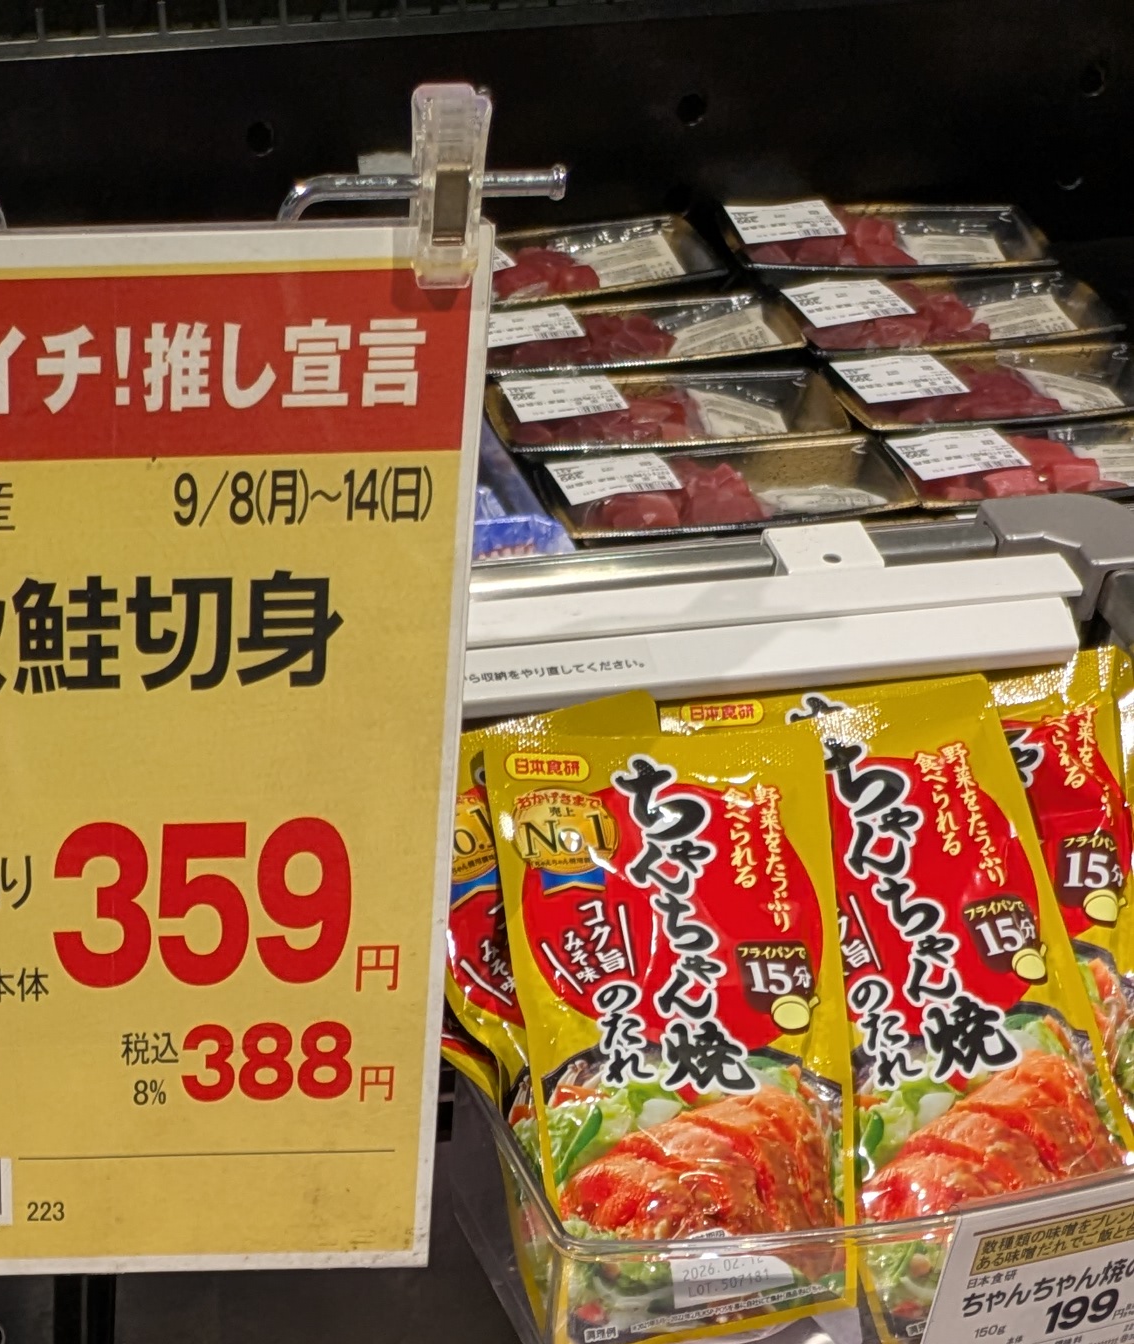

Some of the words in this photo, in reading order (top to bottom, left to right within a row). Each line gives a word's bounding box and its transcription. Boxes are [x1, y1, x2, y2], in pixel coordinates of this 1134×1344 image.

[689, 704, 755, 723] 日本食研
[512, 757, 582, 779] 日本食研
[913, 750, 963, 857] 食べられる
[721, 785, 758, 890] 食べられる
[1063, 852, 1110, 888] 15
[53, 817, 352, 988] 359
[355, 944, 401, 992] 円
[616, 757, 759, 1092] ちゃんちゃん焼
[564, 931, 600, 984] みそ味
[579, 900, 628, 974] コク旨
[736, 945, 807, 961] フライパンで
[975, 917, 1023, 957] 15
[745, 958, 791, 996] 15
[793, 964, 815, 993] 分
[597, 983, 651, 1086] のたれ
[850, 975, 923, 1087] のたれ
[121, 1032, 179, 1066] 税込
[181, 1020, 353, 1102] 388
[360, 1065, 395, 1103] 円
[132, 1079, 167, 1107] 8%
[26, 1202, 65, 1222] 223
[967, 1269, 1018, 1290] 日本食研
[974, 1324, 1006, 1339] 150g
[1044, 1288, 1119, 1335] 199
